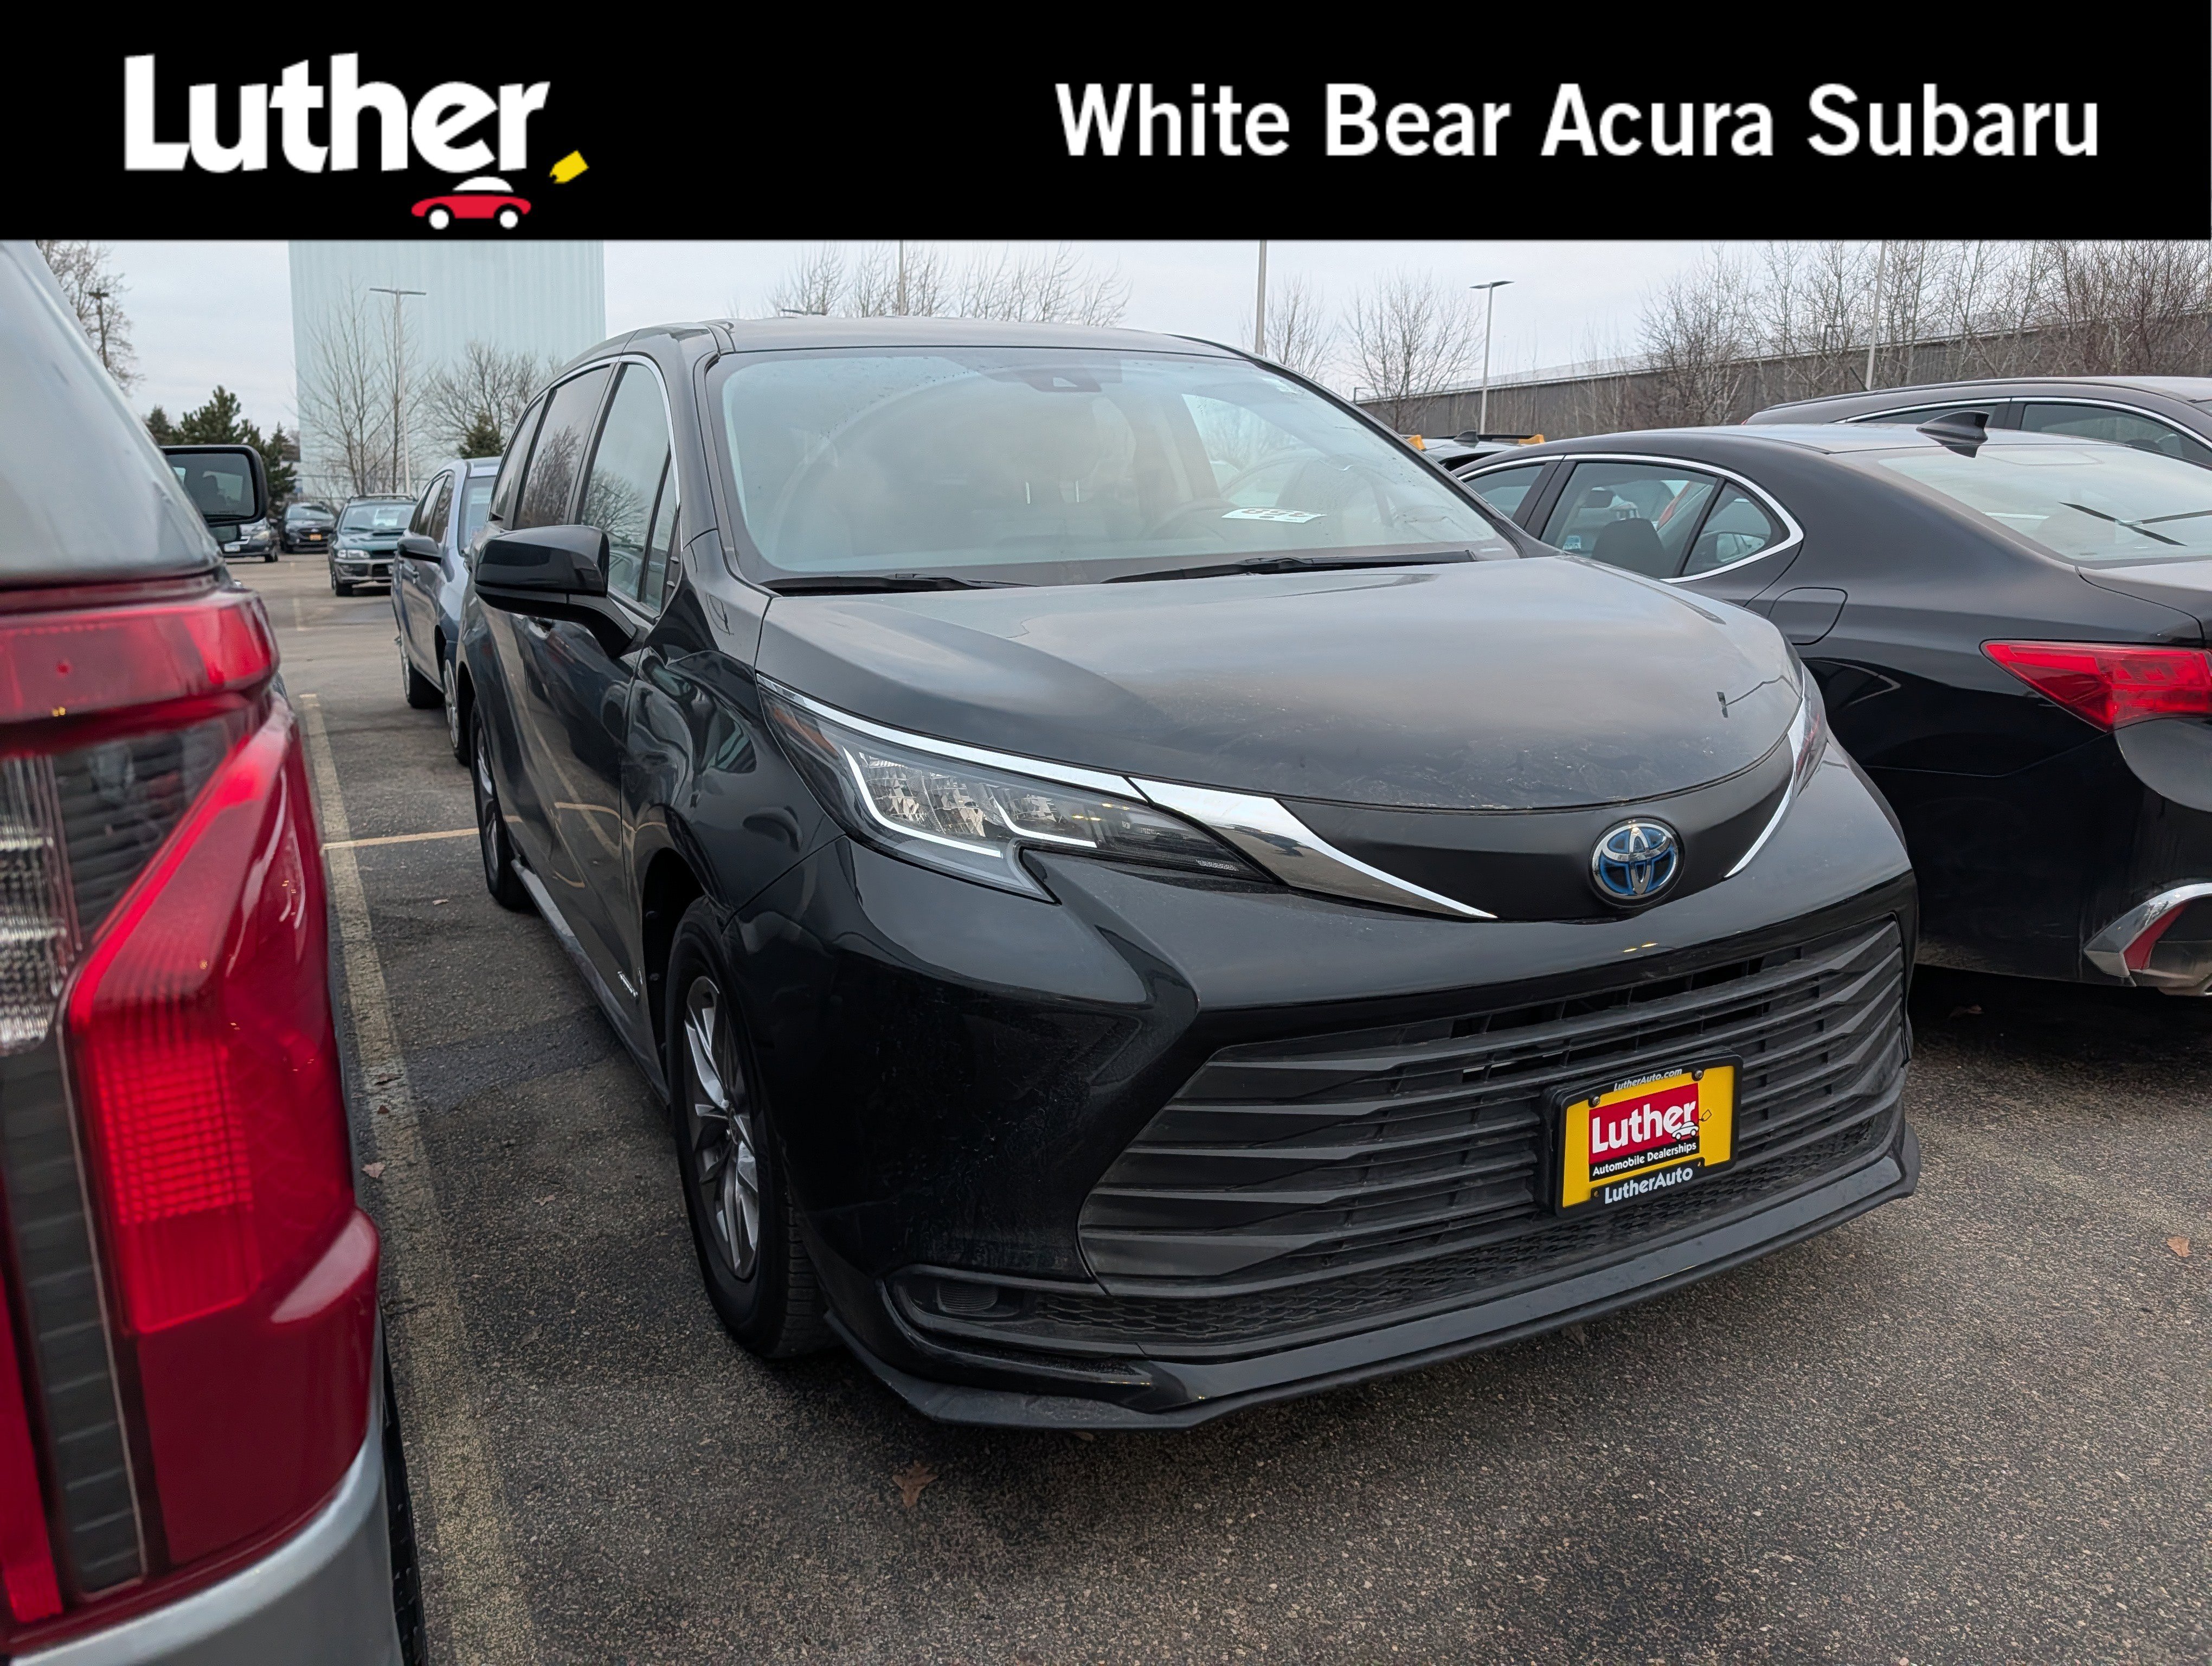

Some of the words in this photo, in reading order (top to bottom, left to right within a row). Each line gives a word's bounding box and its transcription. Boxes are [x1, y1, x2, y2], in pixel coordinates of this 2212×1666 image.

[1613, 1068, 1682, 1092] LutherAuto.com
[1592, 1100, 1696, 1154] Luther
[1592, 1155, 1645, 1176] Automobile
[1647, 1142, 1697, 1162] Dealerships
[1604, 1167, 1693, 1204] LutherAuto
